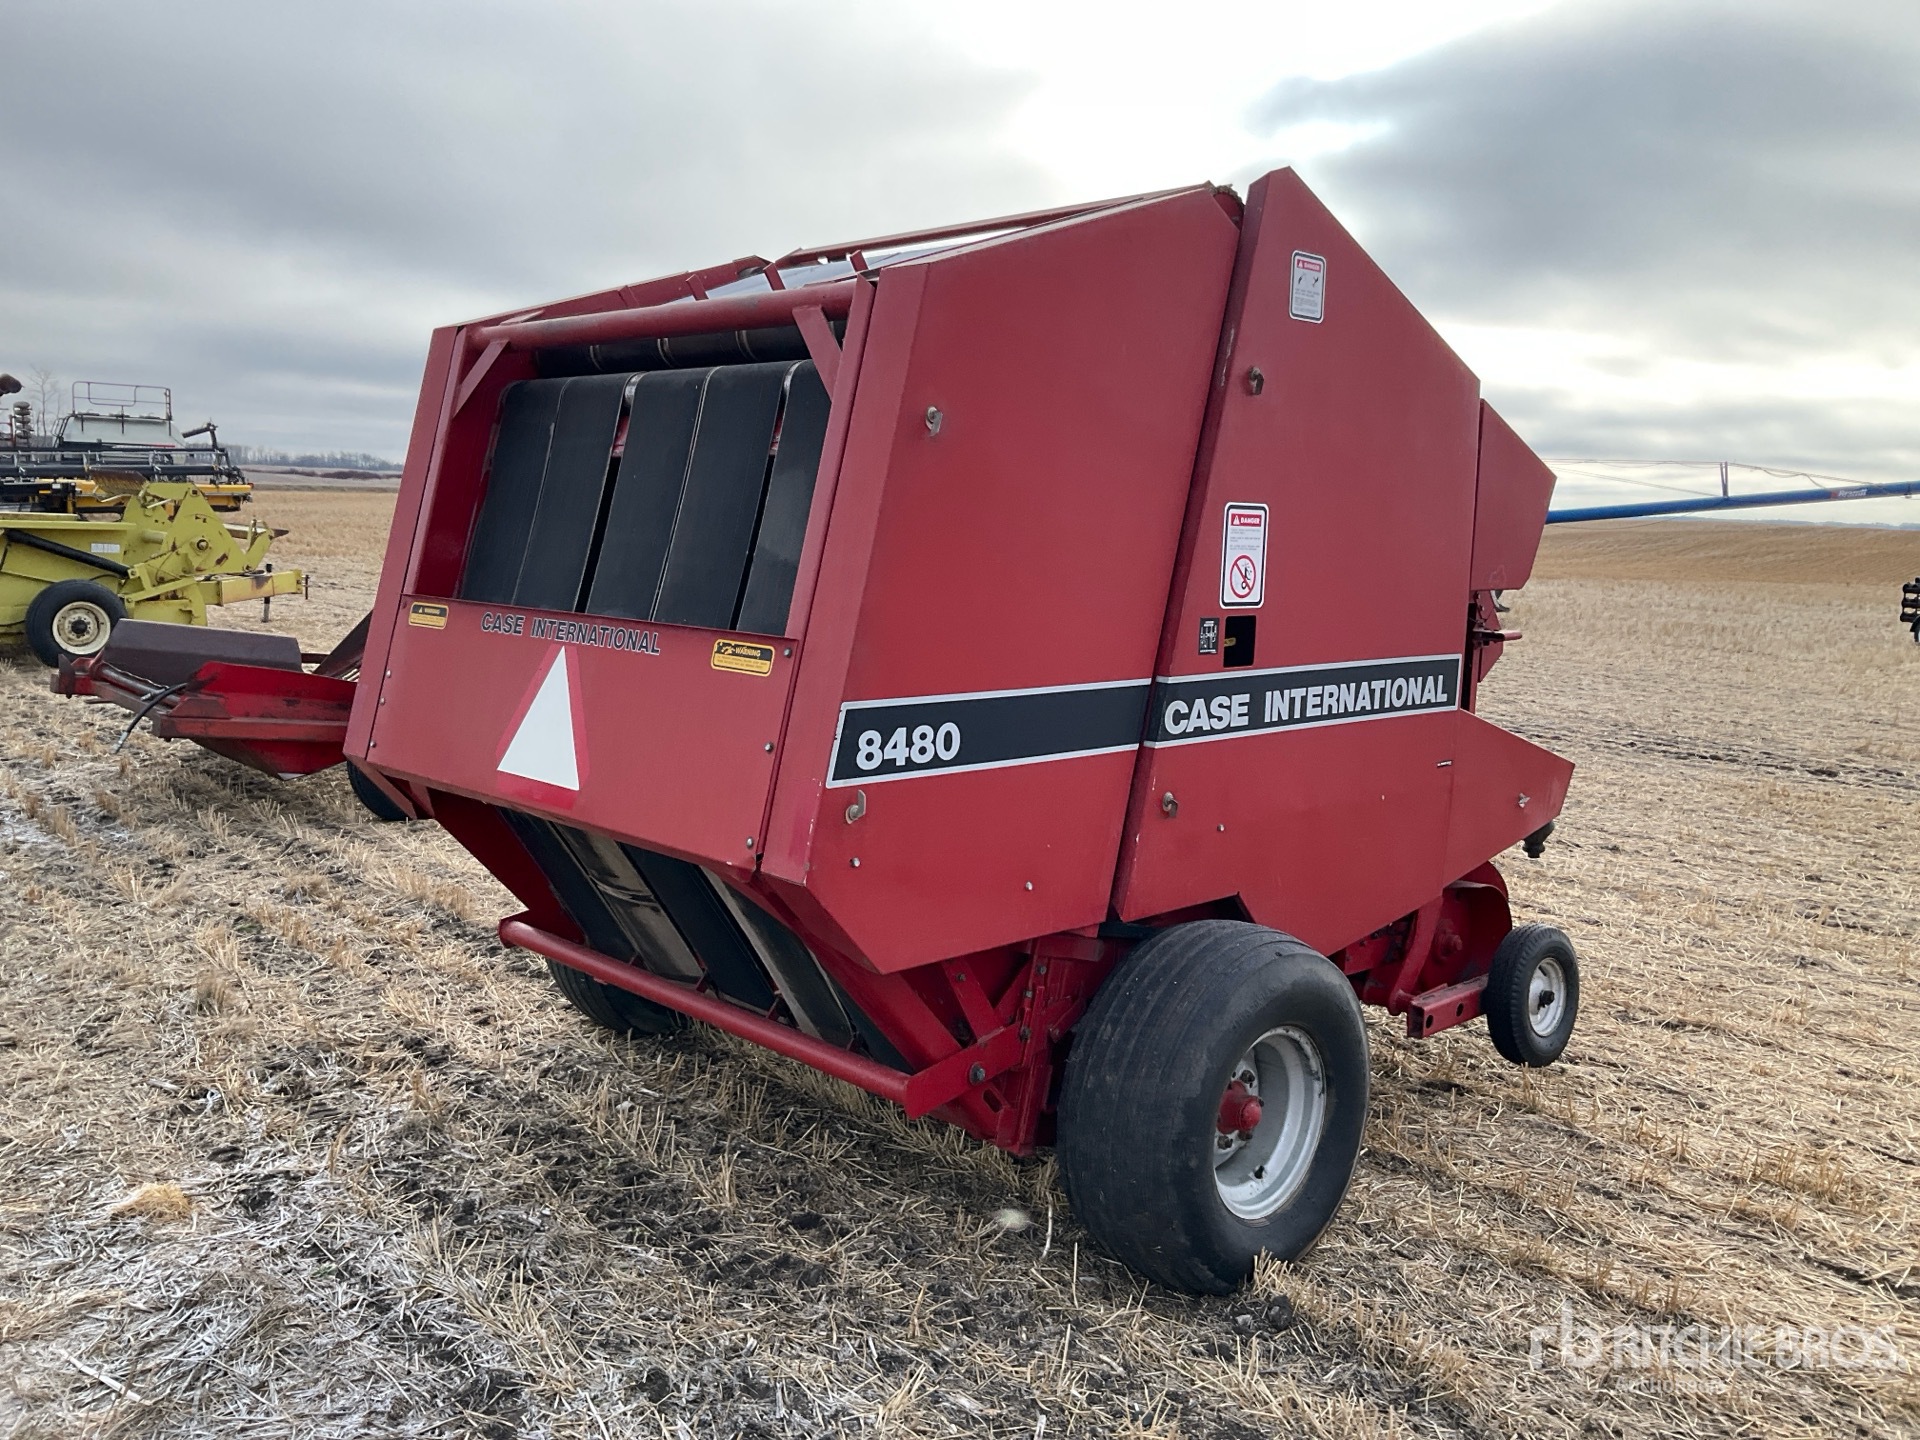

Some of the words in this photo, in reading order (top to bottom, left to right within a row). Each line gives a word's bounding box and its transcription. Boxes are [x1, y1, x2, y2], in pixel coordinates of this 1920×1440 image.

[1240, 517, 1260, 525] DANGER
[482, 612, 525, 635] CASE
[531, 617, 661, 655] INTERNATIONAL
[1164, 694, 1250, 735] CASE
[1264, 674, 1448, 722] INTERNATIONAL
[856, 722, 961, 770] 8480
